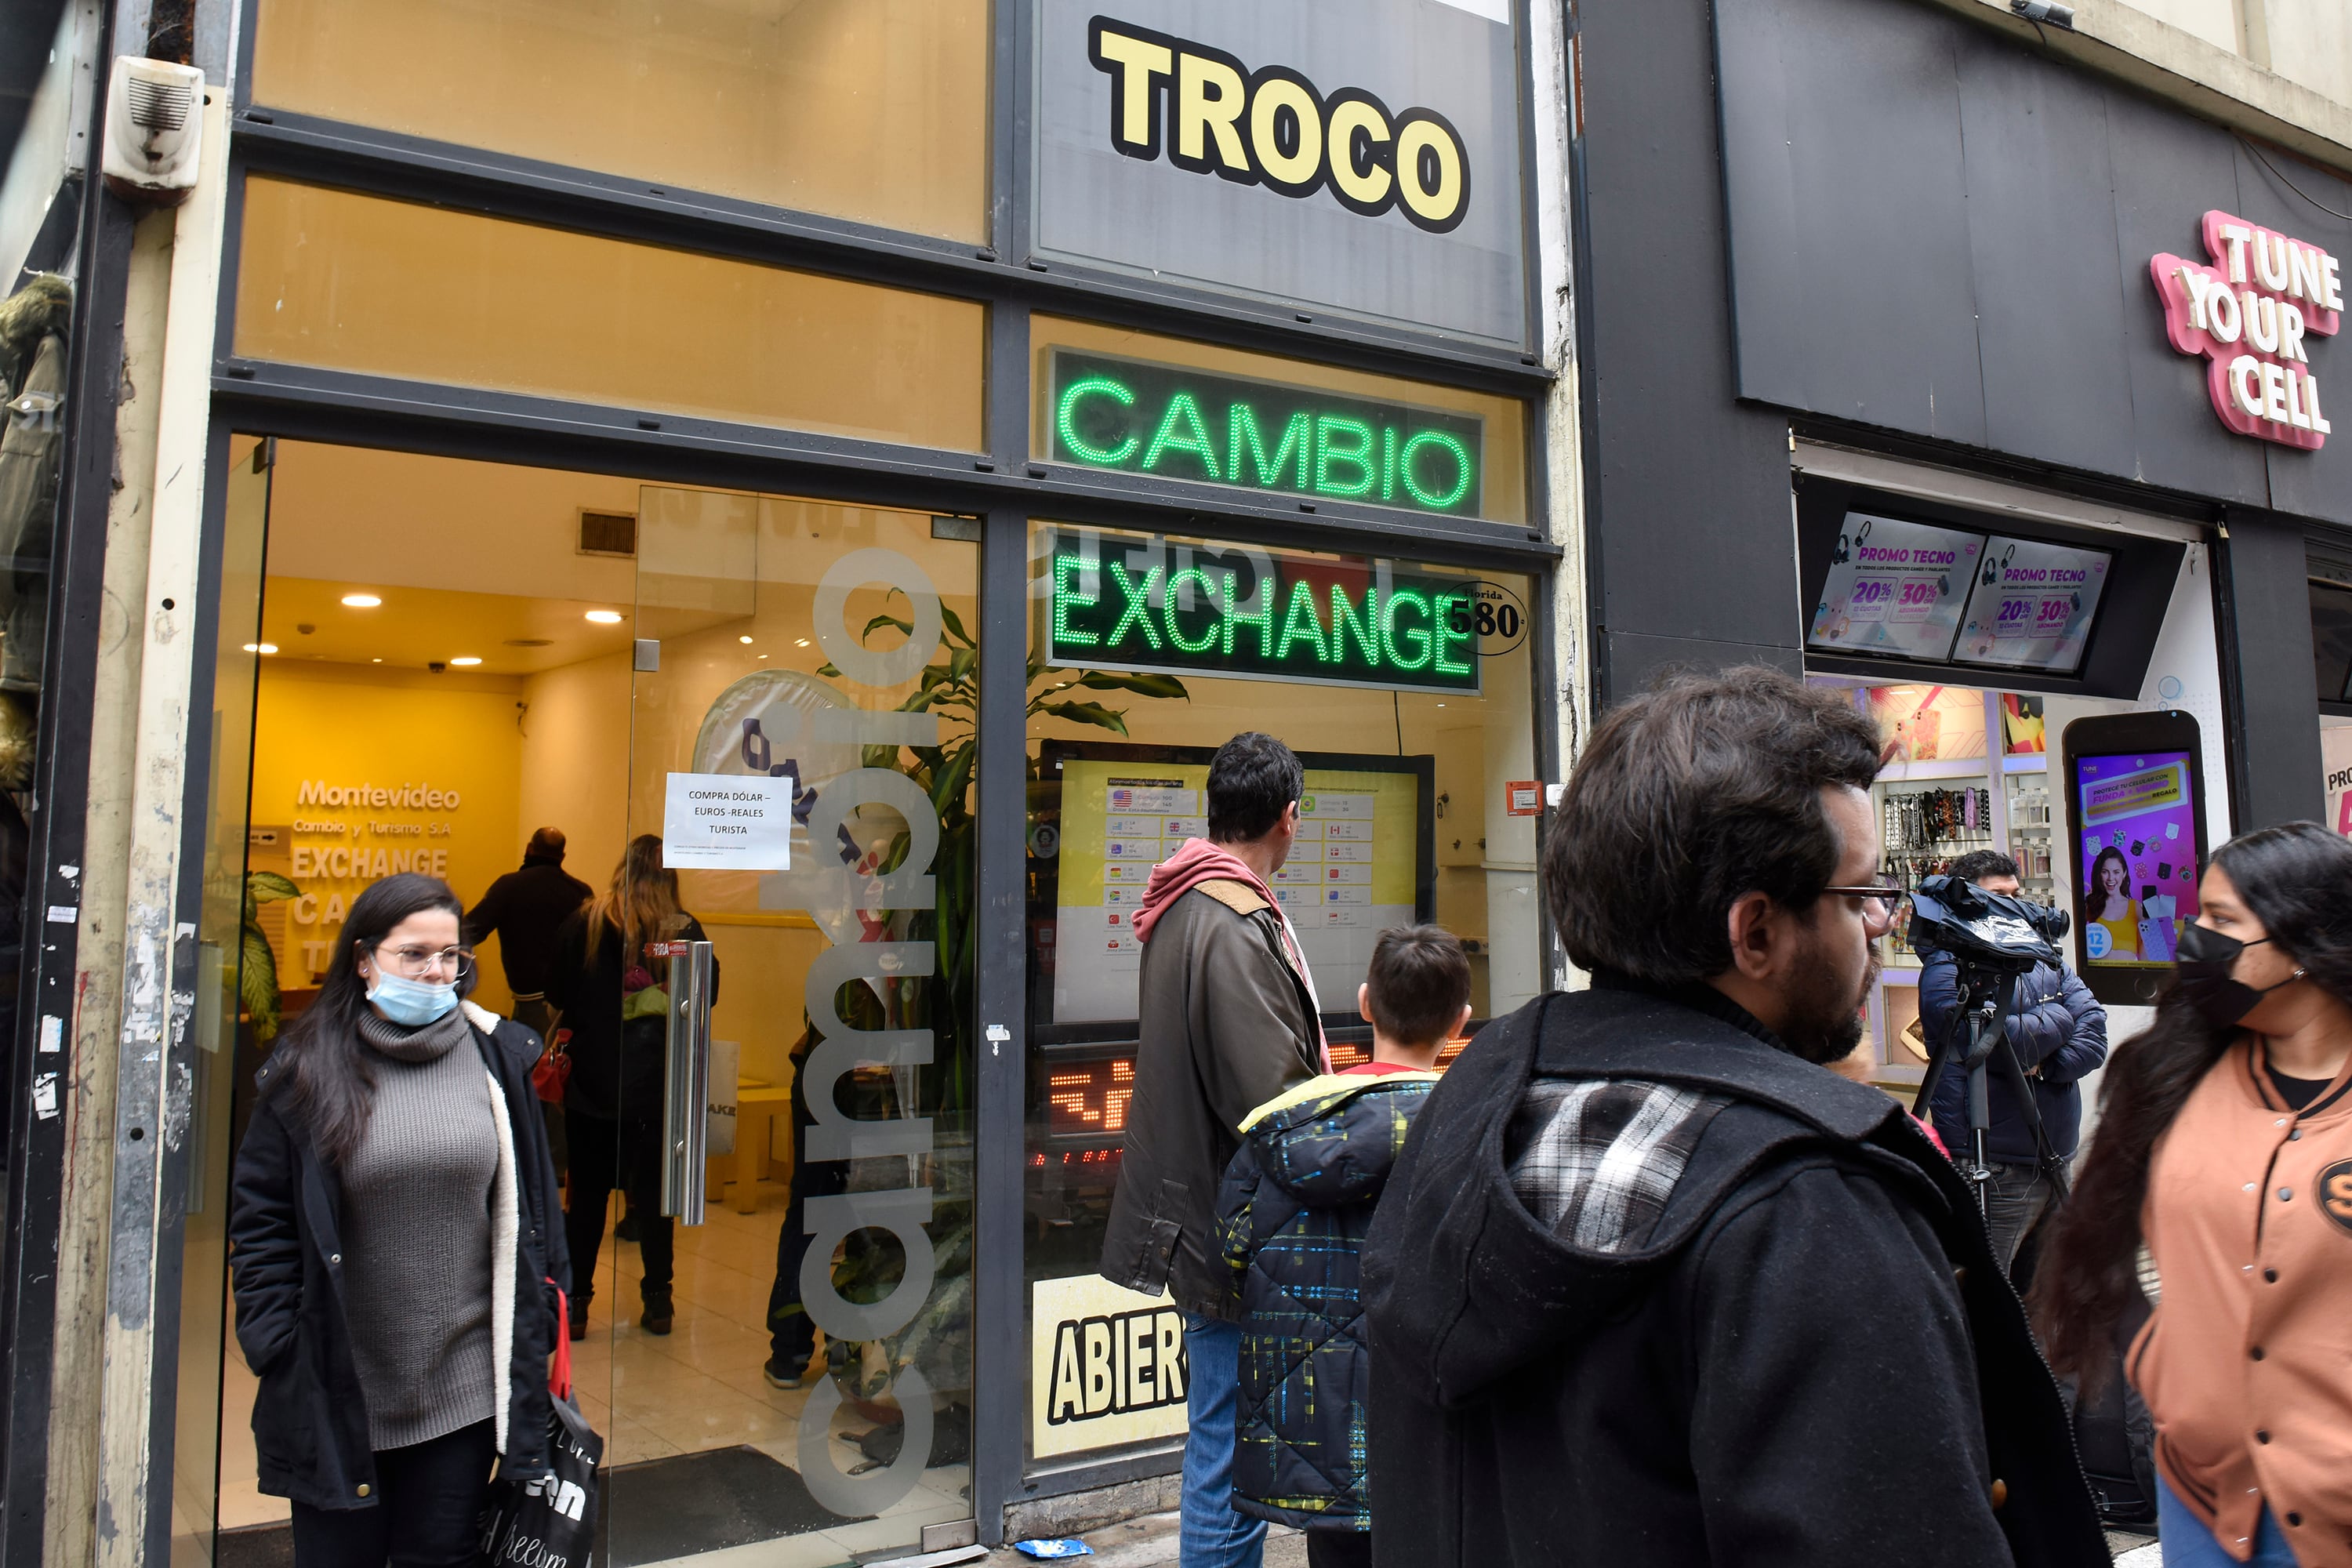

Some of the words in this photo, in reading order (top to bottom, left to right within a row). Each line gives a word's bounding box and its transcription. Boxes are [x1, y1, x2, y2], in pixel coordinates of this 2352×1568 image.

[1099, 28, 1462, 222] TROCO
[2220, 224, 2344, 311] TUNE
[2176, 266, 2308, 363] YOUR
[2230, 354, 2331, 434] CELL
[1058, 379, 1470, 508] CAMBIO
[1858, 547, 1909, 562] PROMO
[1913, 550, 1955, 564] TECNO
[2004, 568, 2047, 582] PROMO
[2049, 569, 2086, 583] TECNO
[1465, 590, 1503, 601] Florida
[1852, 582, 1891, 604] 20%
[1897, 583, 1937, 605] 30%
[1054, 556, 1472, 674] EXCHANGE
[1450, 600, 1519, 638] 580
[1998, 601, 2032, 621] 20%
[2037, 601, 2071, 621] 30%
[2129, 776, 2154, 788] CELULAR
[297, 779, 460, 810] Montevideo
[689, 790, 729, 800] COMPRA
[732, 791, 763, 801] DÓLAR
[2093, 790, 2125, 804] FUNDA
[2152, 788, 2177, 798] REGALO
[695, 807, 725, 816] EUROS
[292, 819, 346, 833] Cambio
[353, 824, 362, 837] y
[368, 821, 422, 834] Turismo
[710, 825, 748, 834] TURISTA
[291, 846, 448, 878] EXCHANGE
[2088, 932, 2103, 946] 12
[758, 546, 942, 1518] cambio
[1052, 1310, 1185, 1420] ABIER
